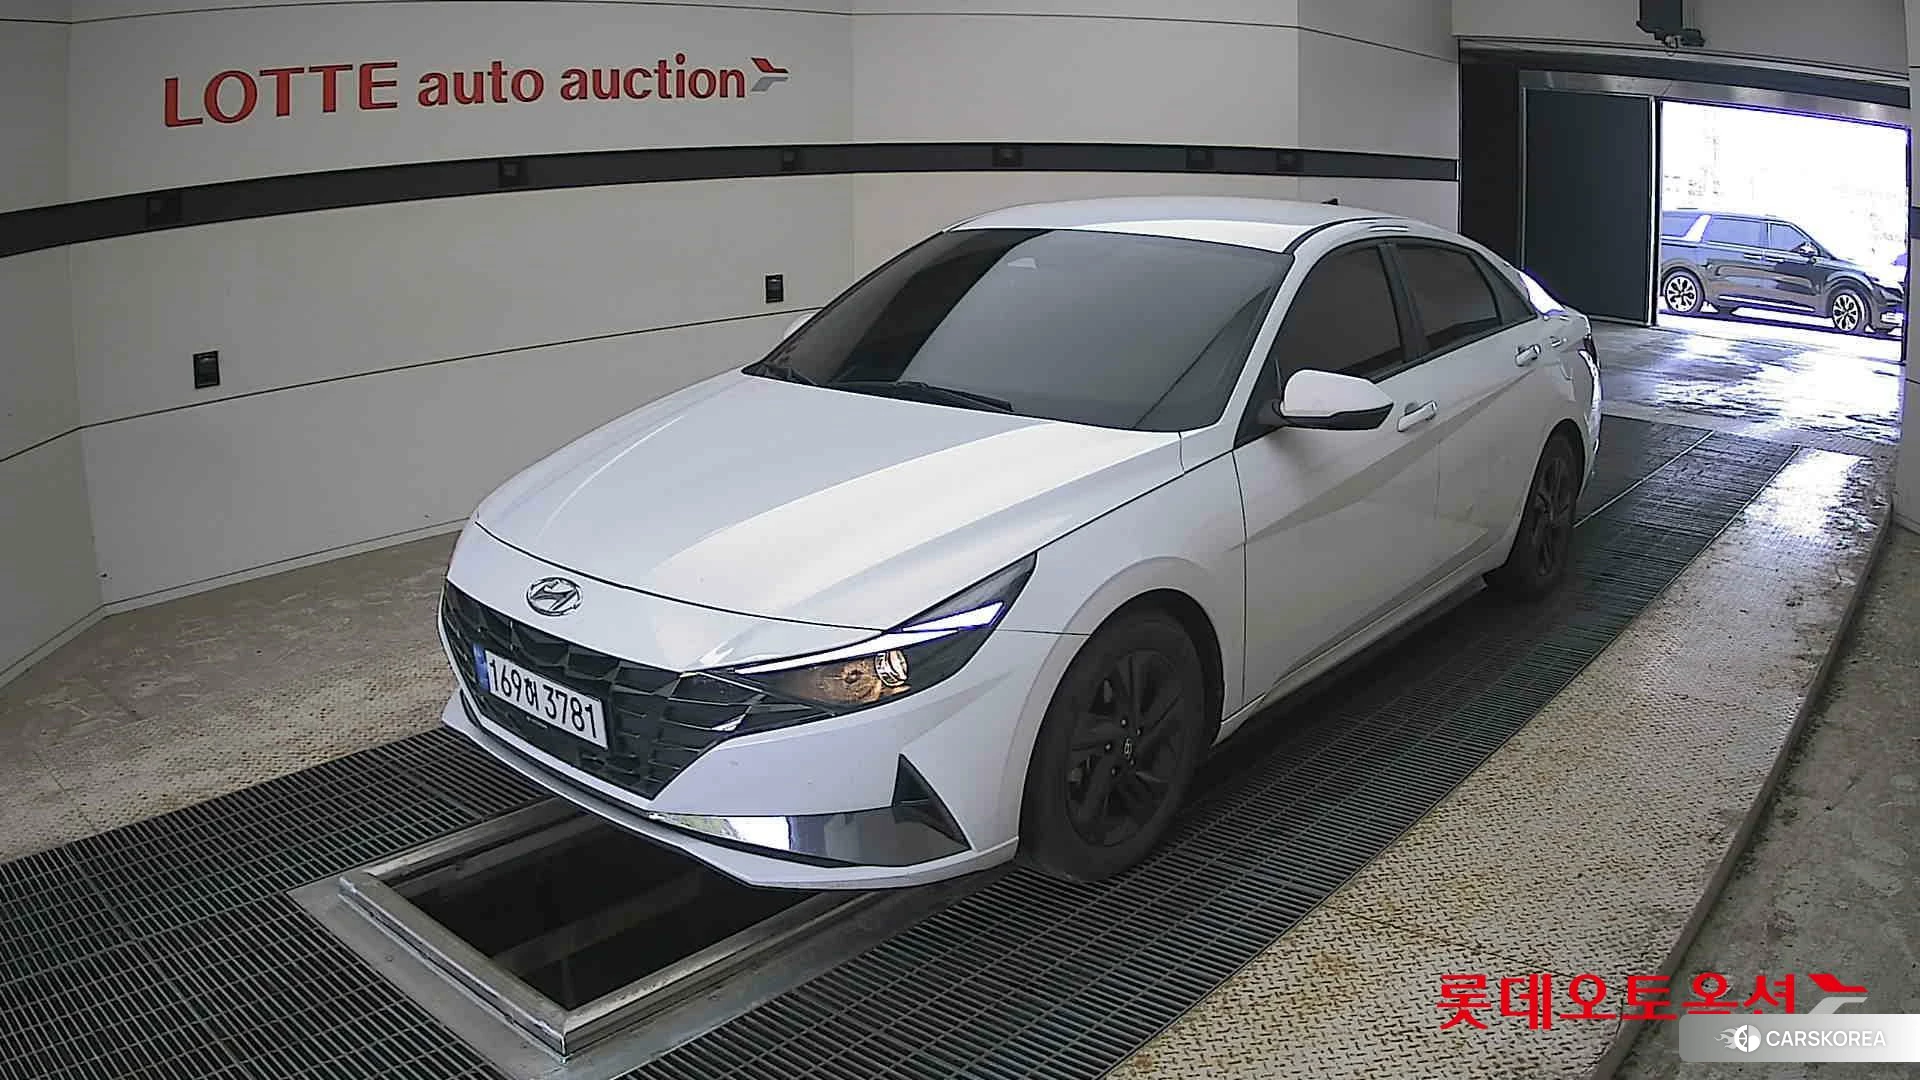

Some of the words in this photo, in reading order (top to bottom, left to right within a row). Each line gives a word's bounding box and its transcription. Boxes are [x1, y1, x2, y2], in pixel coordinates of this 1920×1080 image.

[164, 61, 399, 128] LOTTE
[418, 60, 545, 107] auto
[560, 53, 746, 100] auction
[543, 684, 597, 739] 3781
